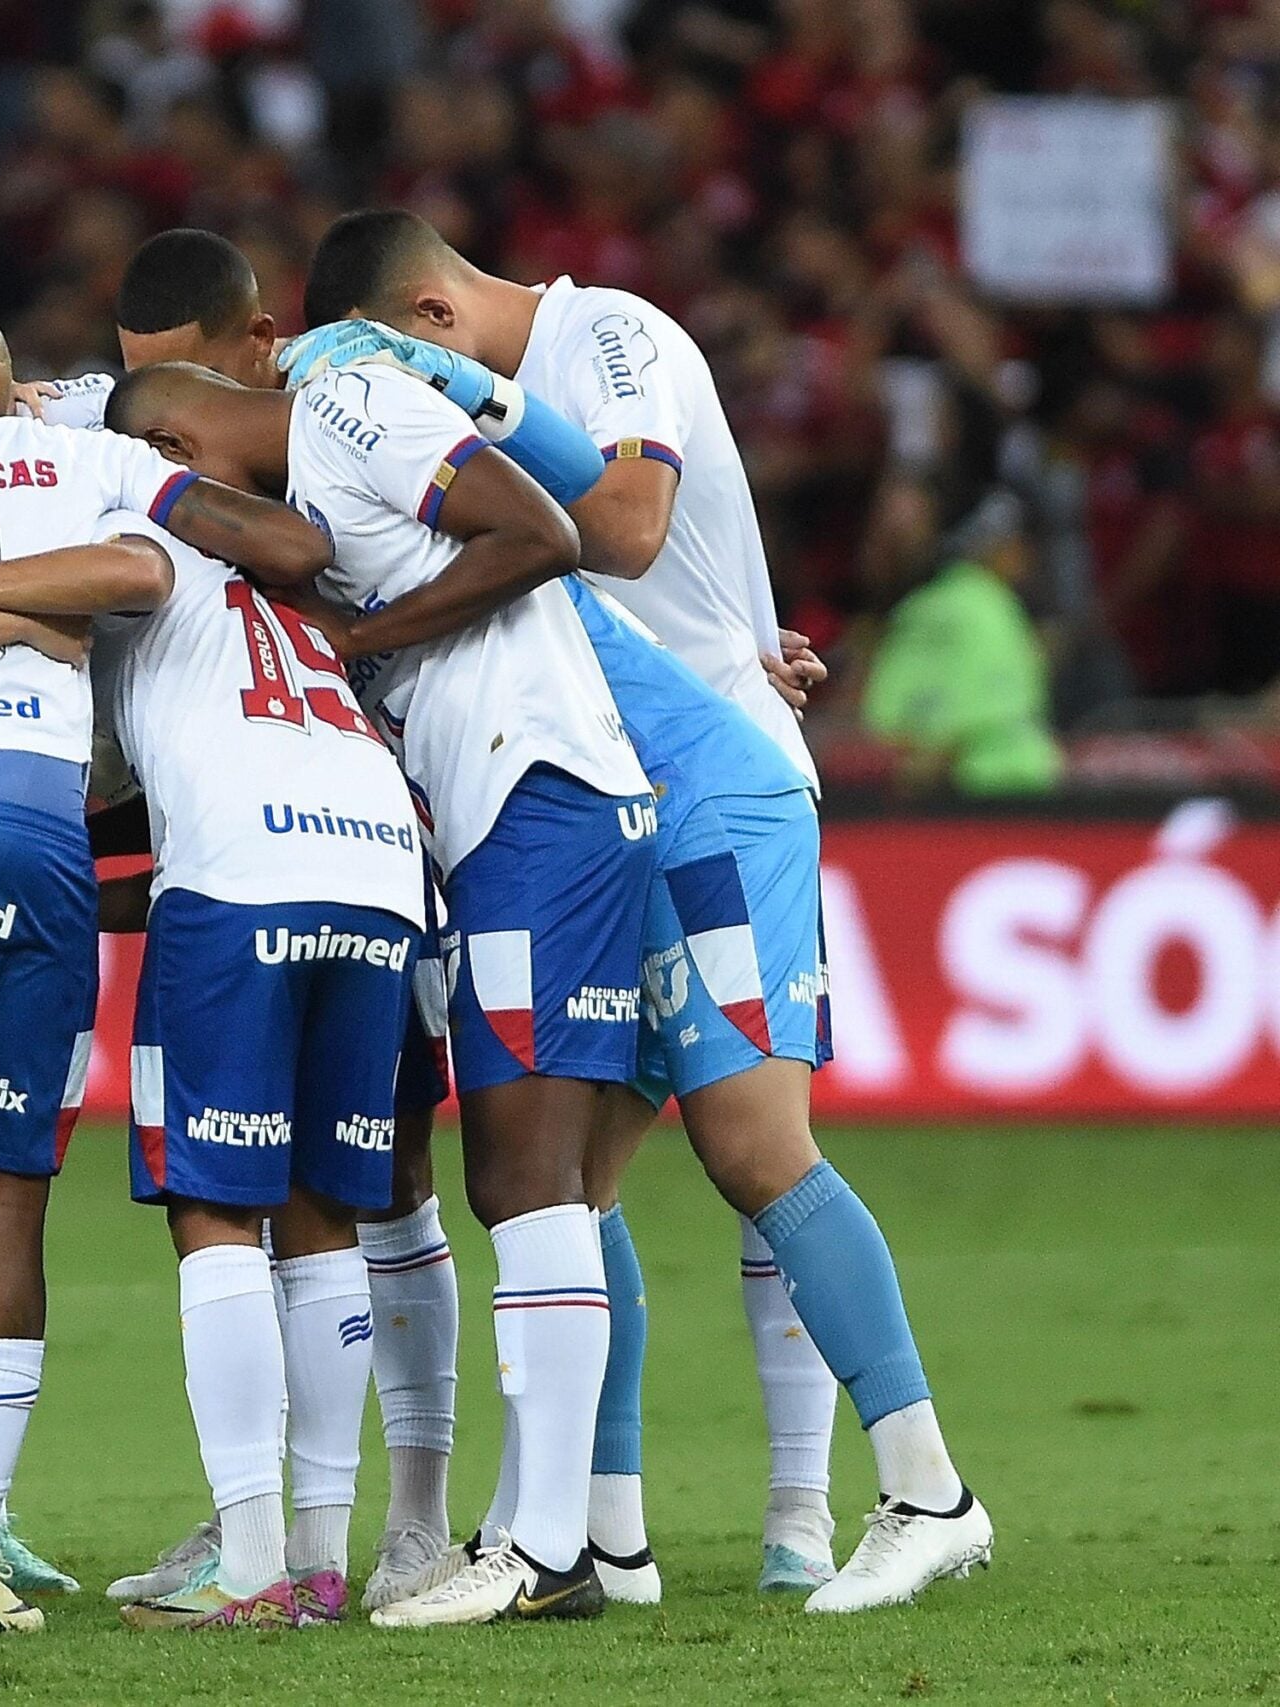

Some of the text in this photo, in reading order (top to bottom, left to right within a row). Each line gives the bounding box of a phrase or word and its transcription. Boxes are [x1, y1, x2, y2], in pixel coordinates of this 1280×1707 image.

[251, 620, 279, 681] acelen
[261, 802, 415, 853] Unimed
[254, 925, 411, 973] Unimed
[186, 1116, 292, 1148] MULTIVIX
